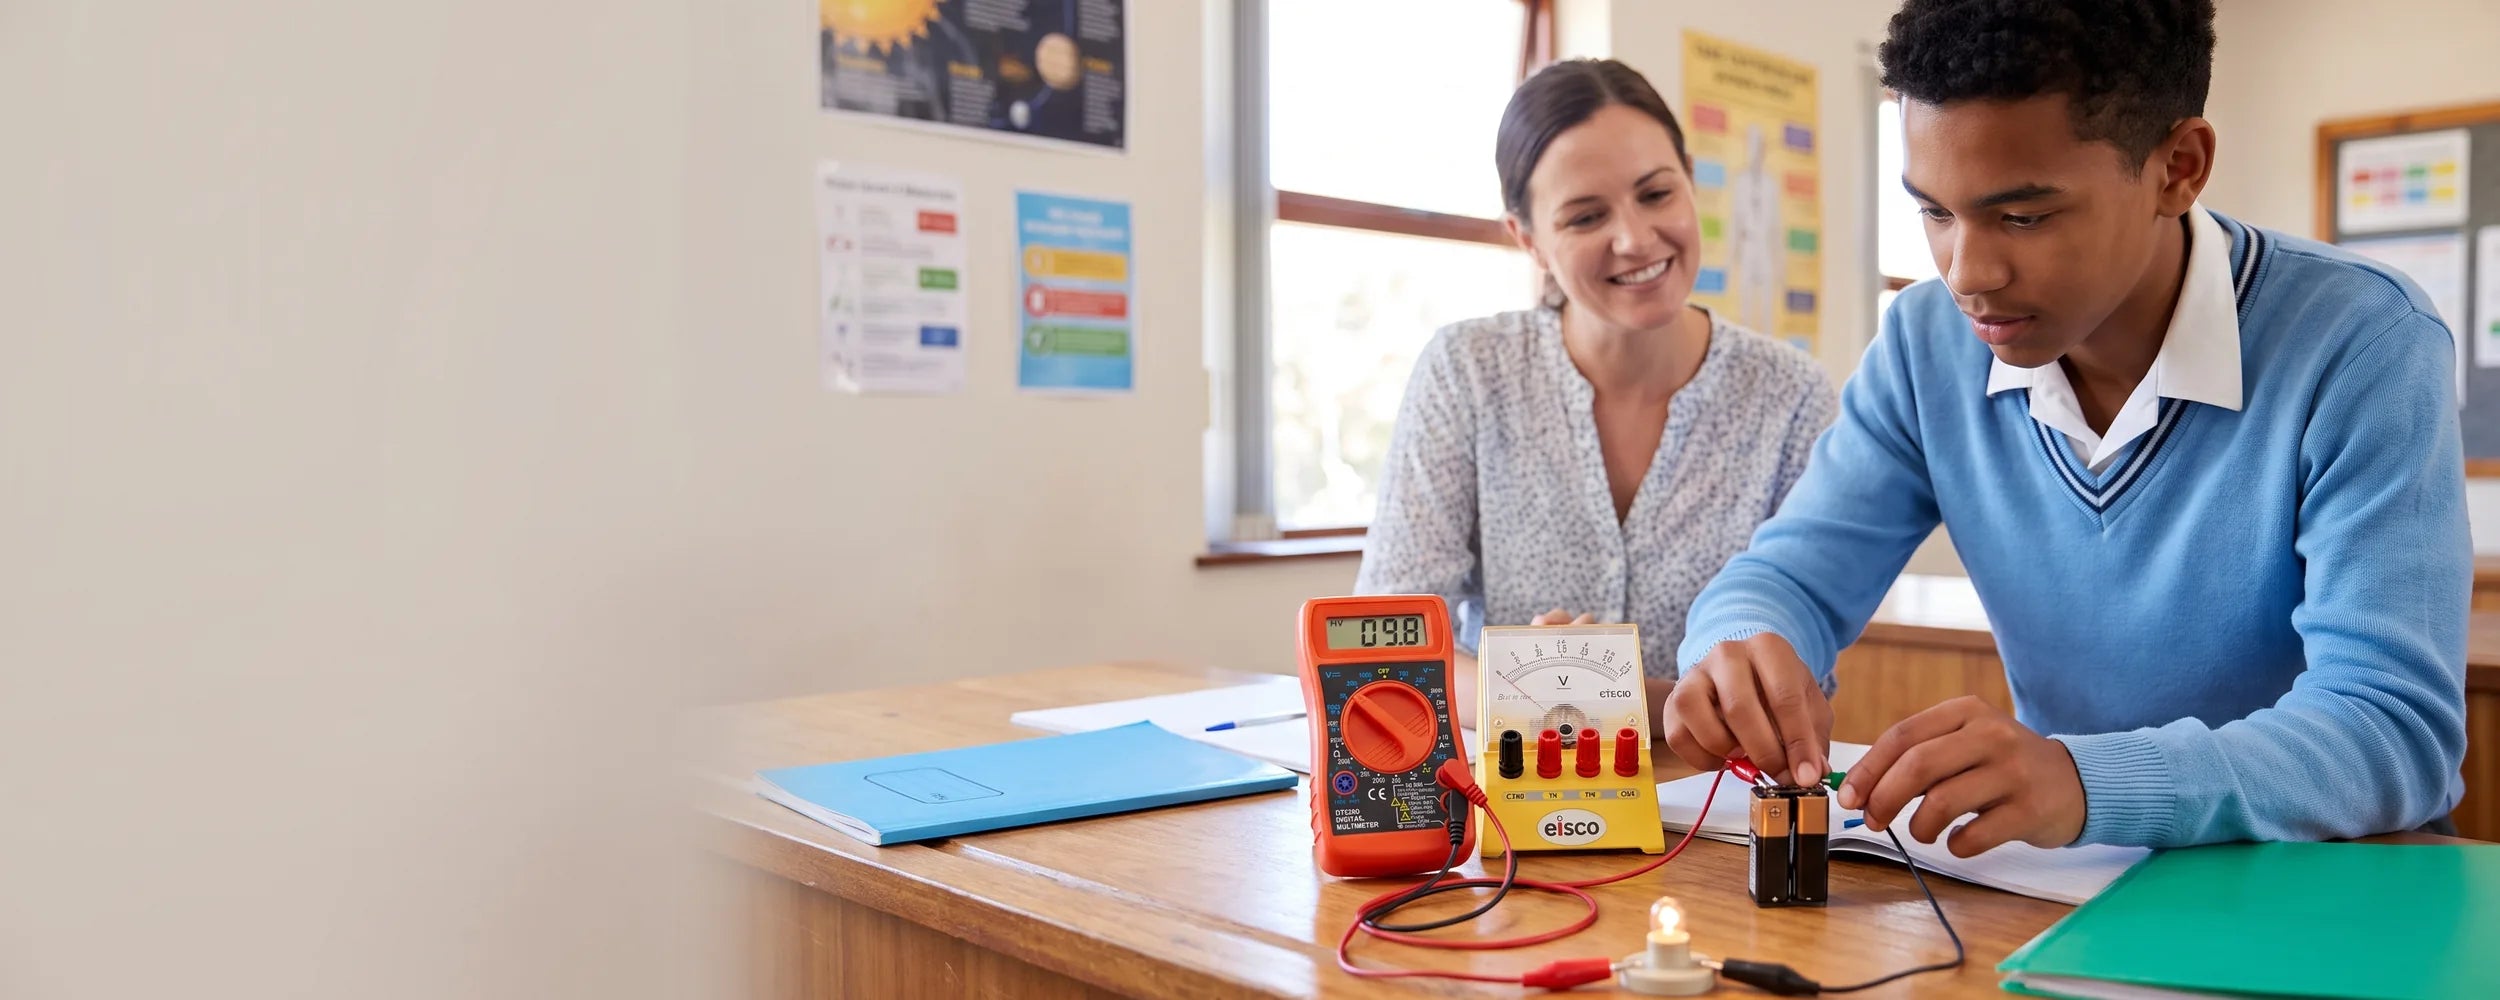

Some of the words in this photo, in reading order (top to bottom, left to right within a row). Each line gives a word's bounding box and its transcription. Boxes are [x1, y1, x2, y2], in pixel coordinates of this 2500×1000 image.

[1361, 618, 1419, 647] 09.8
[1558, 675, 1569, 686] V
[1544, 815, 1600, 837] eisco
